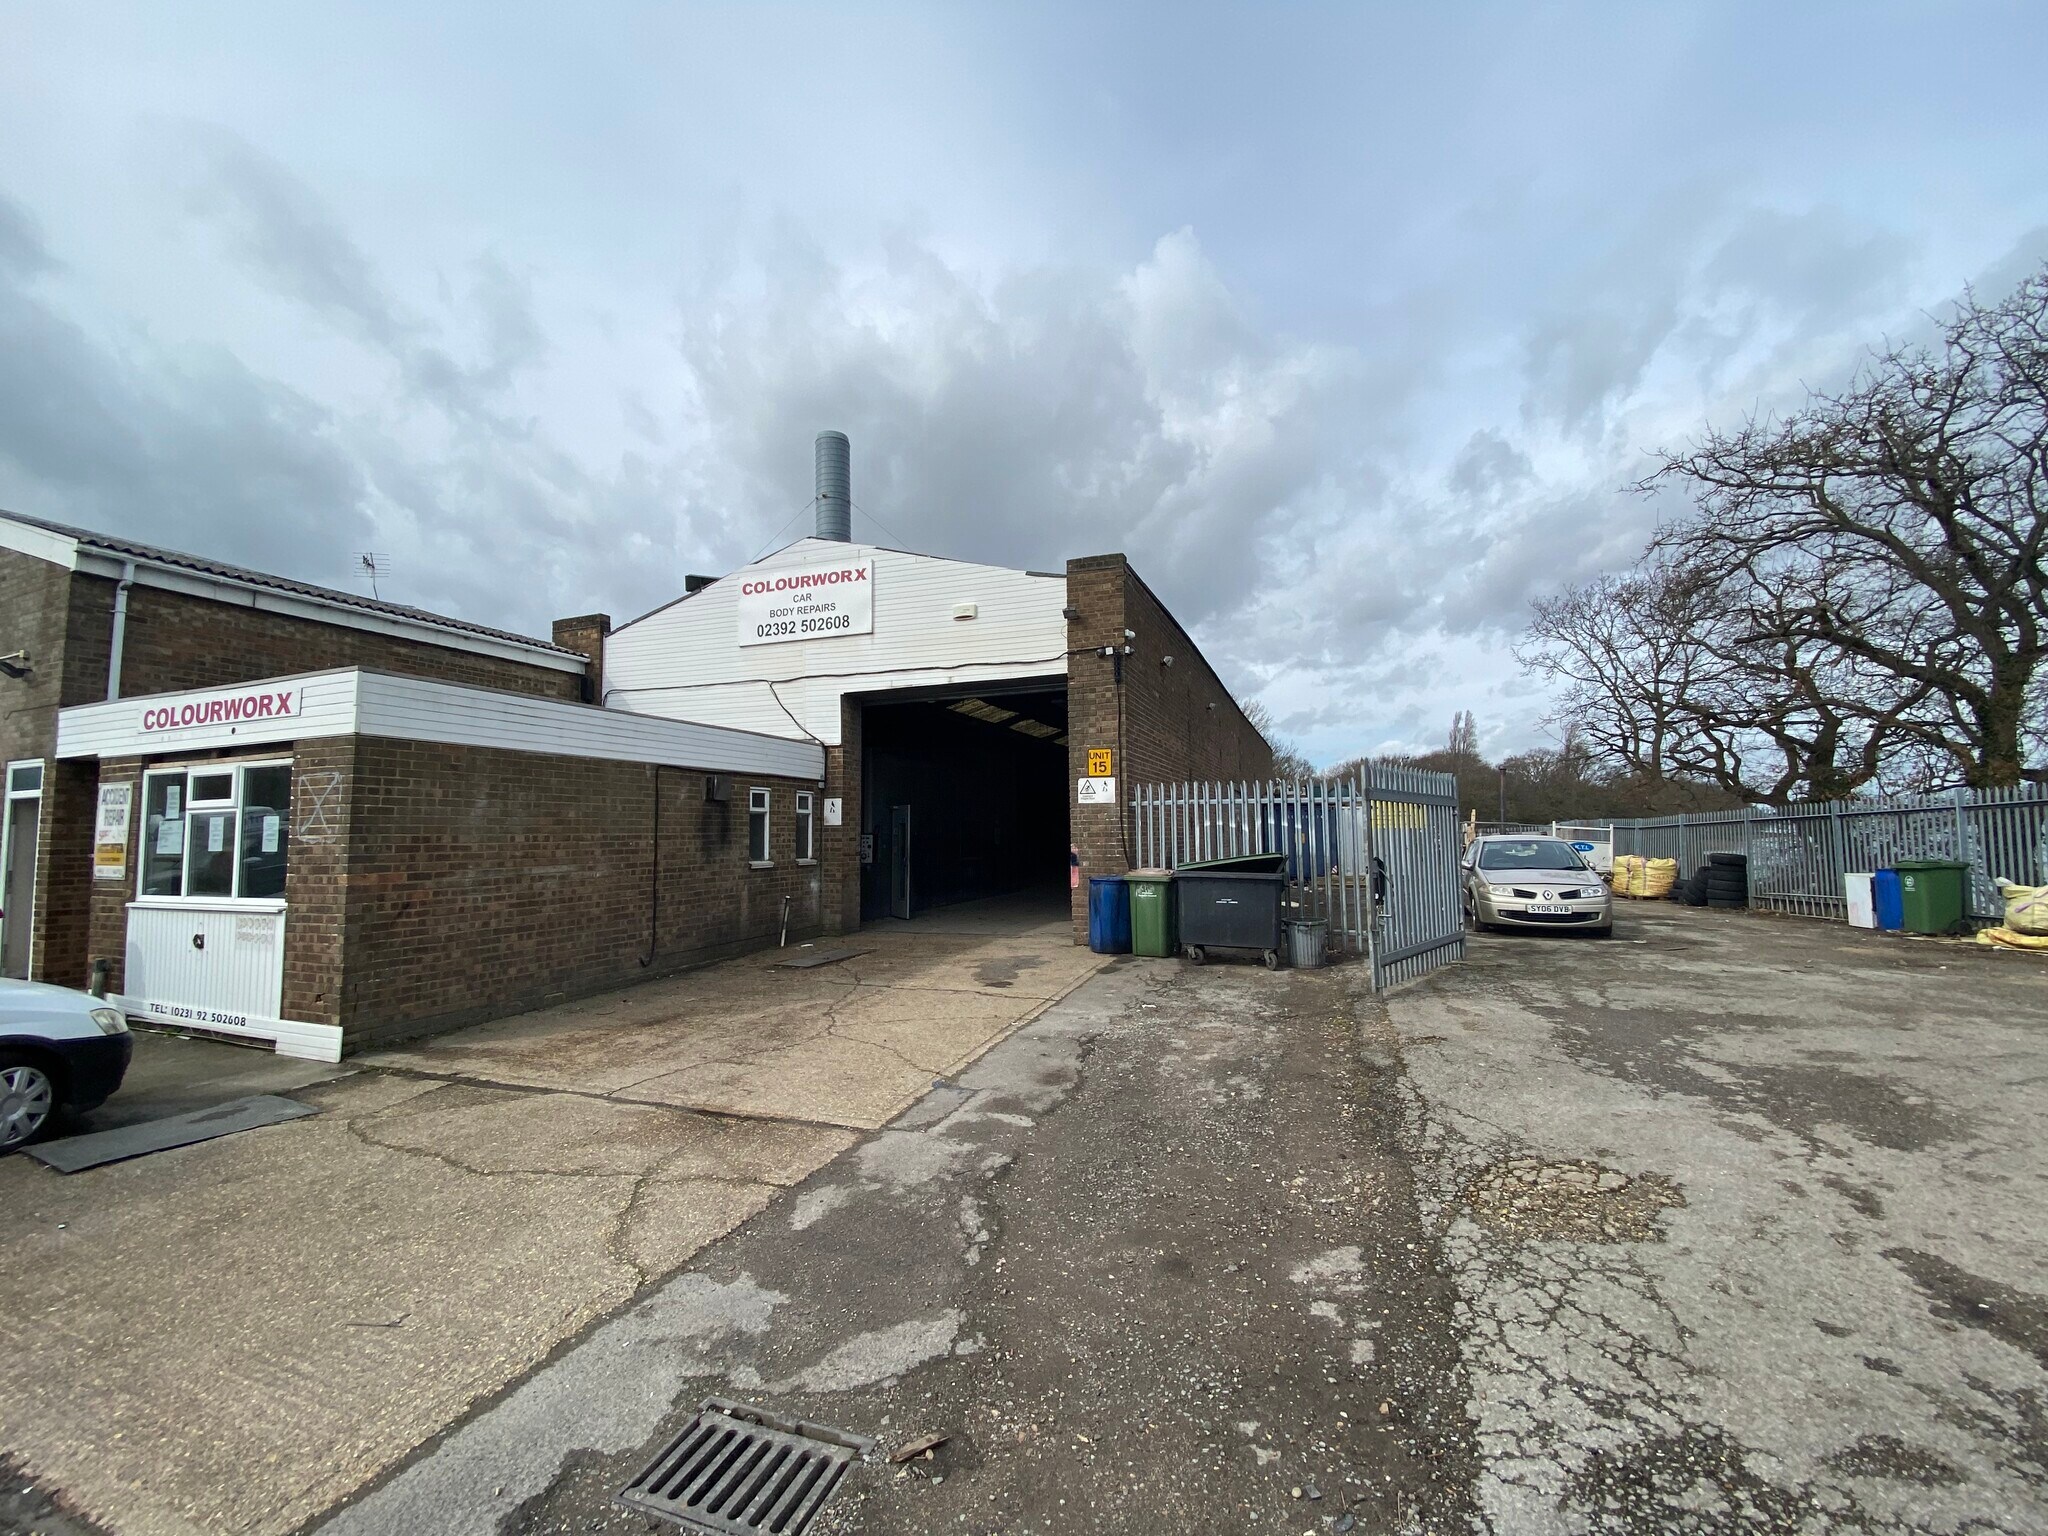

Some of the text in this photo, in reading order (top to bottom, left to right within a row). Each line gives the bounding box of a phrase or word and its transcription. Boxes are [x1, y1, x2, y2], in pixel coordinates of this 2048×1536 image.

[742, 567, 867, 595] COLOURWORX
[793, 593, 812, 603] CAR
[769, 602, 836, 618] BODY REPAIRS
[757, 614, 850, 637] 02392 502608
[143, 692, 293, 731] COLOURWORX
[1089, 751, 1110, 760] UNIT
[1092, 761, 1107, 773] 15
[1530, 905, 1552, 913] SY06
[149, 1002, 168, 1014] TEL:
[196, 1010, 207, 1021] 92
[211, 1012, 247, 1027] 502608
